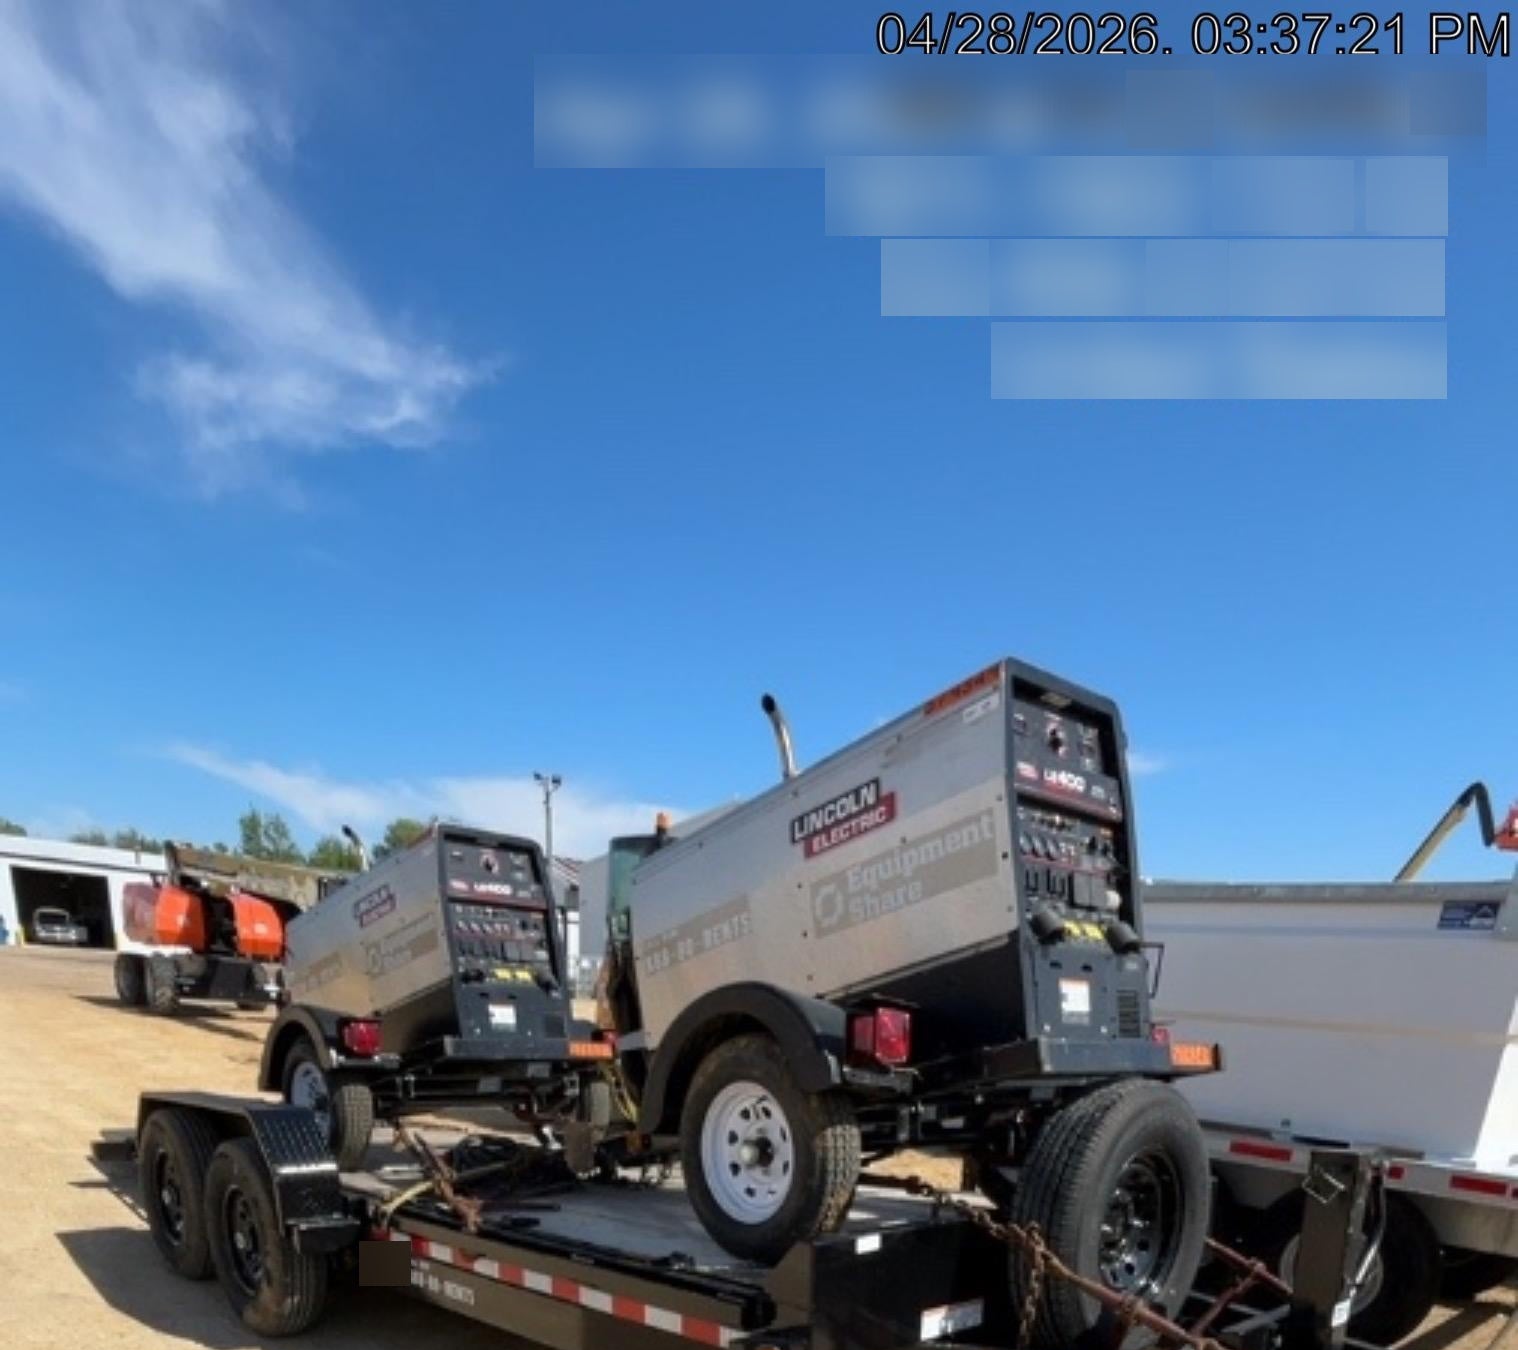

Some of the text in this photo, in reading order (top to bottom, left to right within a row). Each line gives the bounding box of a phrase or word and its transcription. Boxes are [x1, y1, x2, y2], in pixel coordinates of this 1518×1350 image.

[794, 780, 878, 841] LINCOLN
[811, 805, 887, 854] ELECTRIC
[848, 813, 994, 891] Equipment
[848, 880, 924, 921] Share
